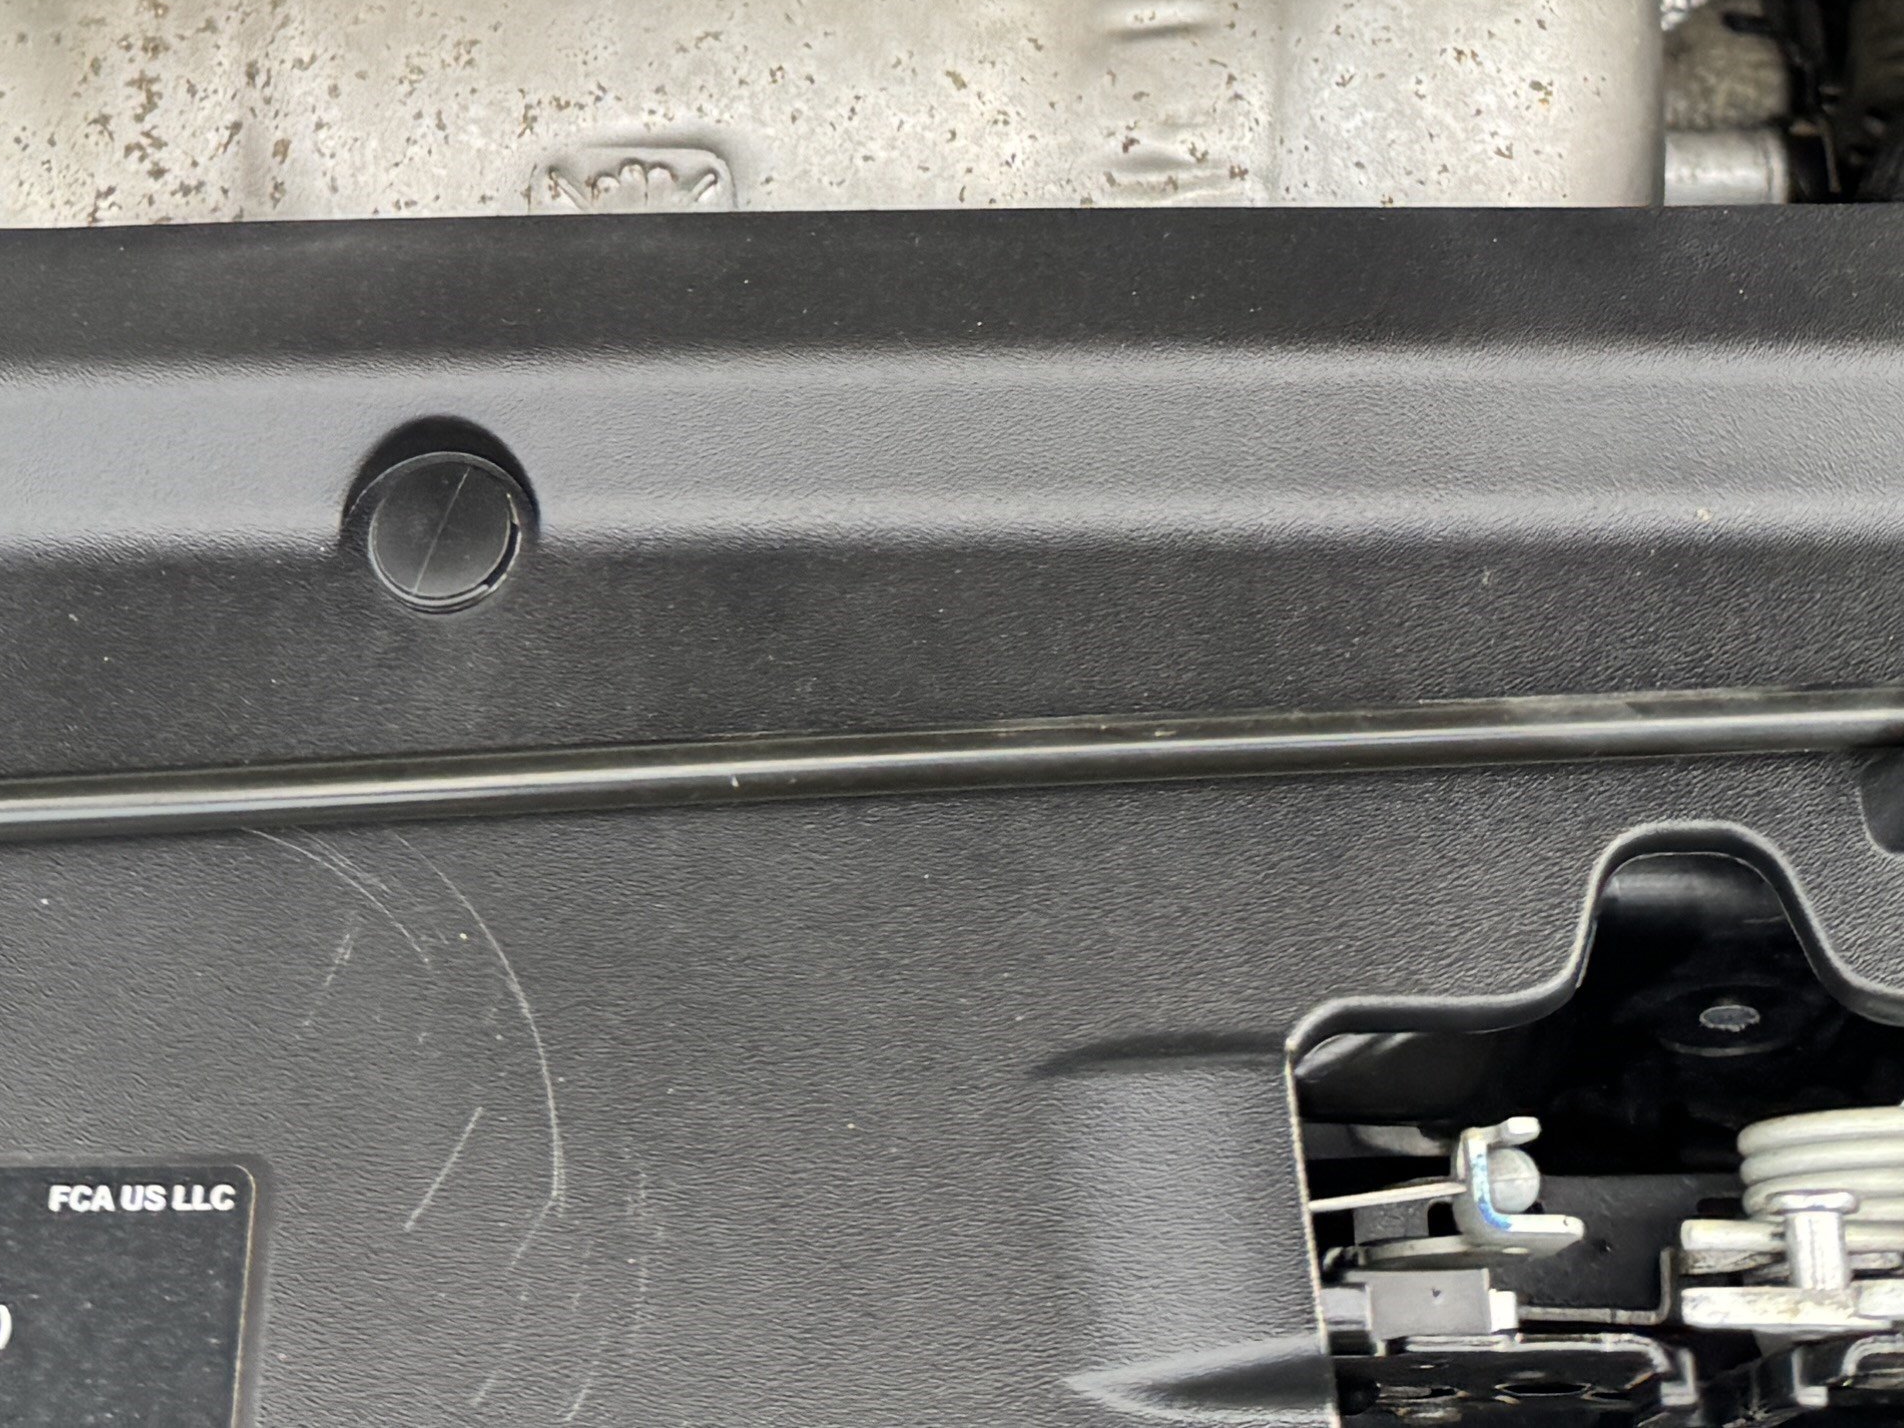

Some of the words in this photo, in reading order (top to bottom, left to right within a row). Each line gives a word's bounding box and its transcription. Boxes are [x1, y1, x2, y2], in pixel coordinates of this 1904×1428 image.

[49, 1185, 116, 1212] FCA
[121, 1184, 164, 1211] US
[170, 1184, 236, 1211] LLC
